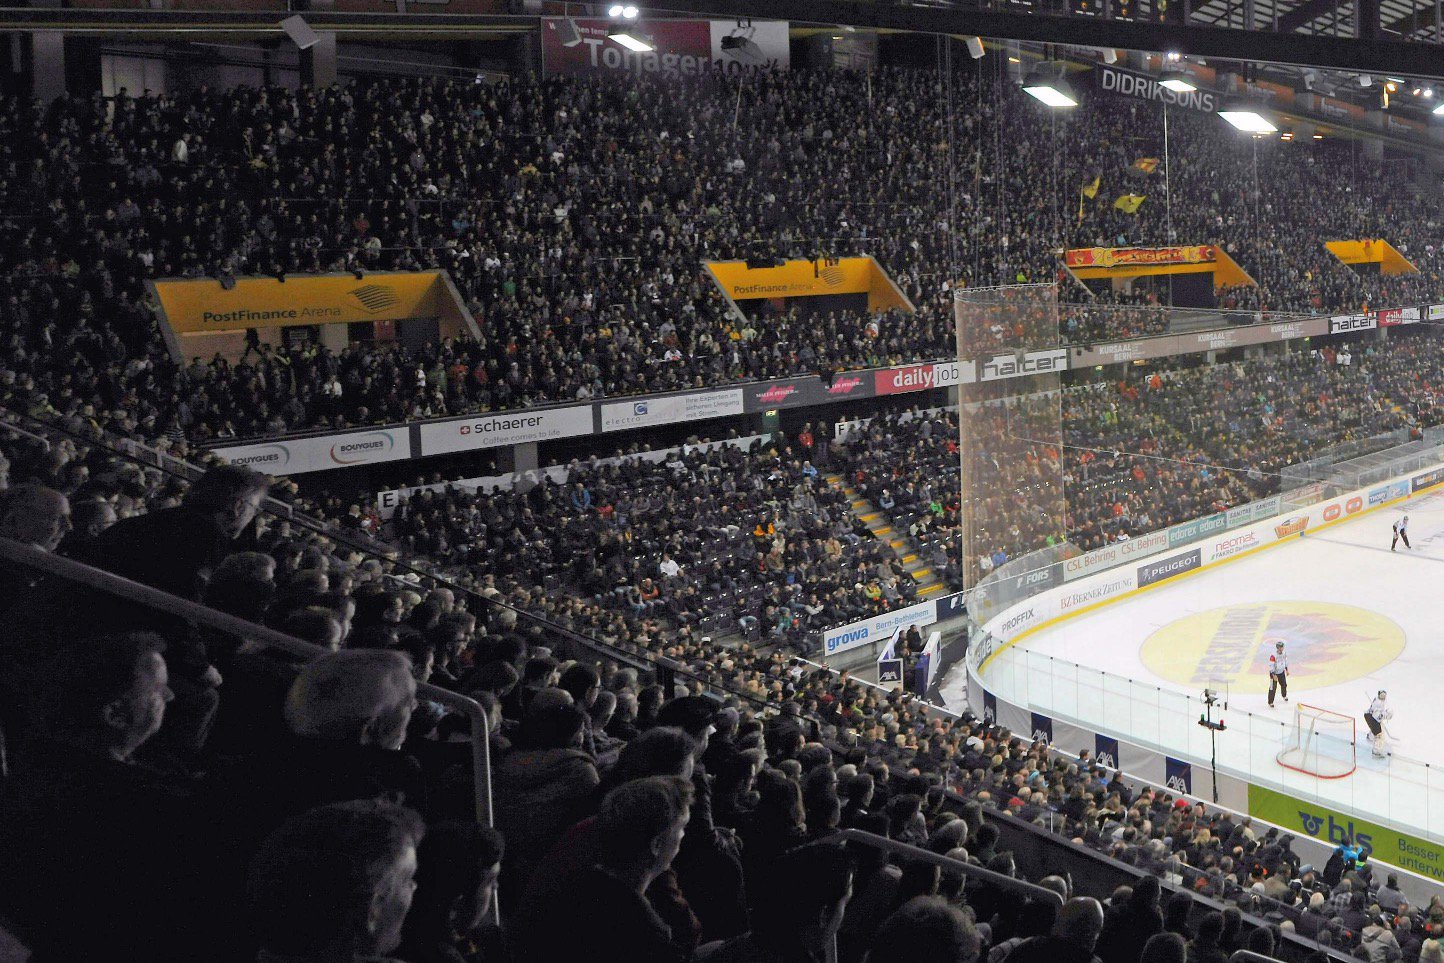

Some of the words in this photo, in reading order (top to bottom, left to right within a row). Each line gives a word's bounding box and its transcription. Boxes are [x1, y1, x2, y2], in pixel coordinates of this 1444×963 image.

[734, 284, 787, 294] PostFinance
[203, 308, 297, 323] PostFinance
[301, 306, 341, 318] Arena
[1100, 344, 1132, 355] KURSAAL
[1114, 352, 1132, 361] BERN
[474, 415, 543, 434] schaerer
[340, 440, 385, 452] BOUYGUES
[483, 435, 509, 446] Coffee
[511, 432, 537, 443] comes
[231, 453, 279, 466] BOUYGUES
[383, 492, 394, 508] E
[1170, 525, 1197, 542] edorex
[1200, 516, 1226, 533] edorex
[1121, 541, 1136, 556] CSL
[1137, 533, 1167, 550] Behring
[1215, 531, 1256, 553] neomat
[1067, 559, 1083, 572] CSL
[1085, 550, 1116, 567] Behring
[1151, 555, 1198, 578] PEUGEOT
[1026, 569, 1049, 585] FORS
[1060, 595, 1073, 609] BZ
[1073, 588, 1102, 606] BERNER
[1102, 577, 1133, 596] ZEITUNG
[876, 608, 929, 631] Bern-Bethlehem
[1001, 607, 1036, 635] PROFFIX
[827, 627, 869, 651] growa
[879, 671, 898, 682] AXA
[1032, 728, 1049, 745] AXA
[1096, 750, 1116, 769] AXA
[1166, 775, 1187, 795] AXA
[1329, 815, 1373, 855] bls
[1398, 838, 1441, 863] Besser
